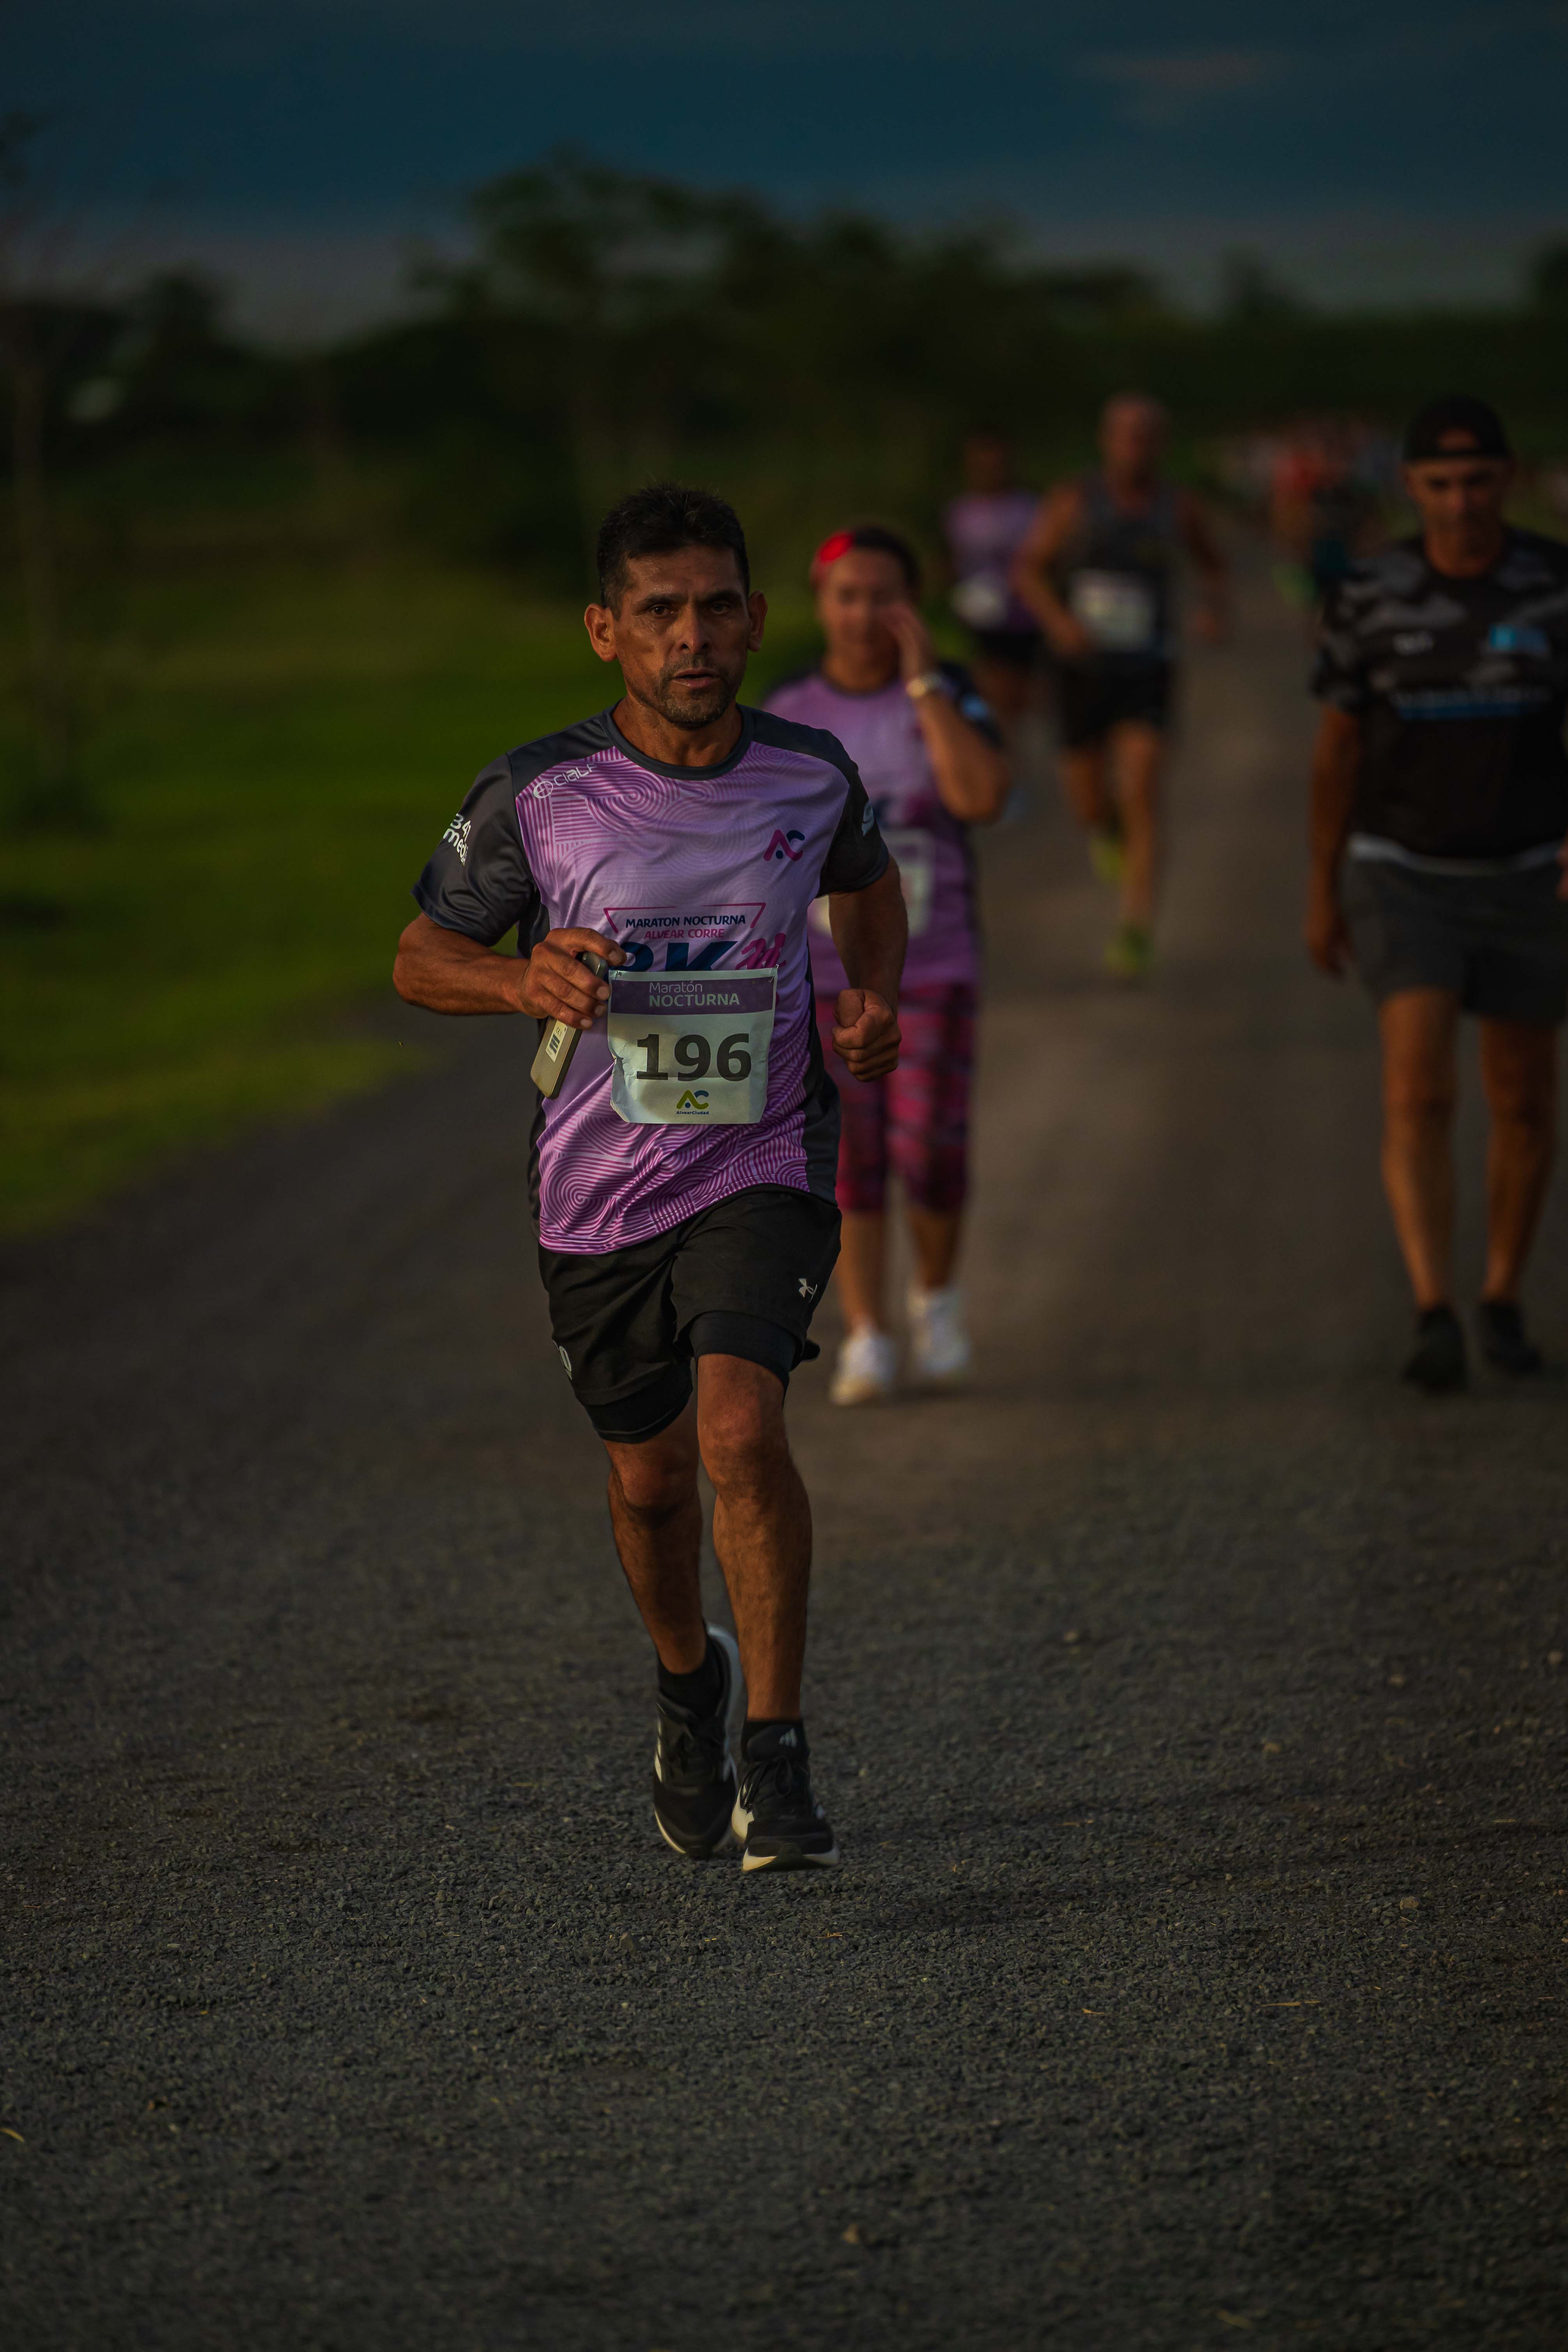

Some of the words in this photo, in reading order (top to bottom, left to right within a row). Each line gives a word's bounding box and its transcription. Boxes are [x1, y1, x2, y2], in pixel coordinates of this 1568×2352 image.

[625, 917, 680, 928] MARATON
[683, 915, 746, 926] NOCTURNA
[644, 929, 684, 939] ALVEAR
[687, 928, 725, 938] CORRE
[649, 980, 703, 993] Maratón
[649, 993, 740, 1007] NOCTURNA
[636, 1033, 752, 1082] 196
[676, 1090, 709, 1110] AC
